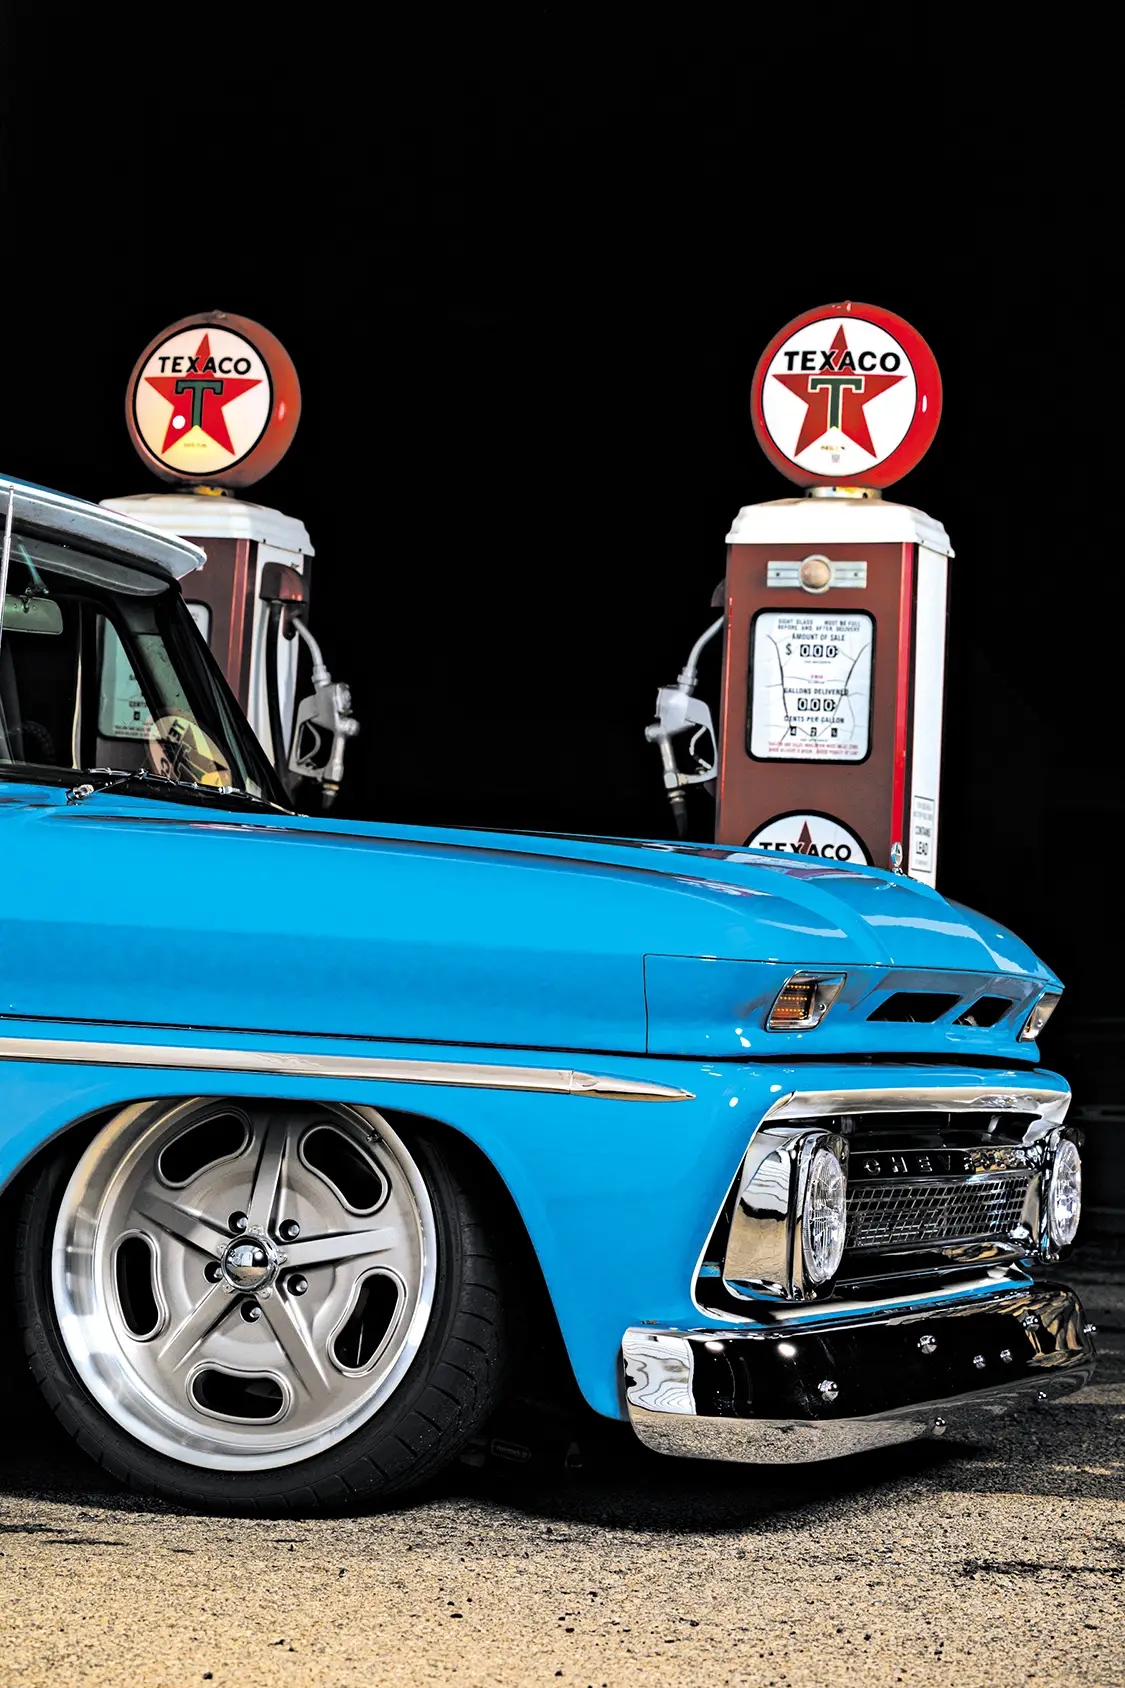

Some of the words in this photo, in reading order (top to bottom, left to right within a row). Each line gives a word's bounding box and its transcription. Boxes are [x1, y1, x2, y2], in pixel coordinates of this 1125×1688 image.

[158, 356, 251, 375] TEXACO
[784, 350, 901, 372] TEXACO
[175, 379, 224, 428] T
[809, 377, 863, 429] T
[785, 642, 792, 656] $
[784, 715, 804, 723] CENTS
